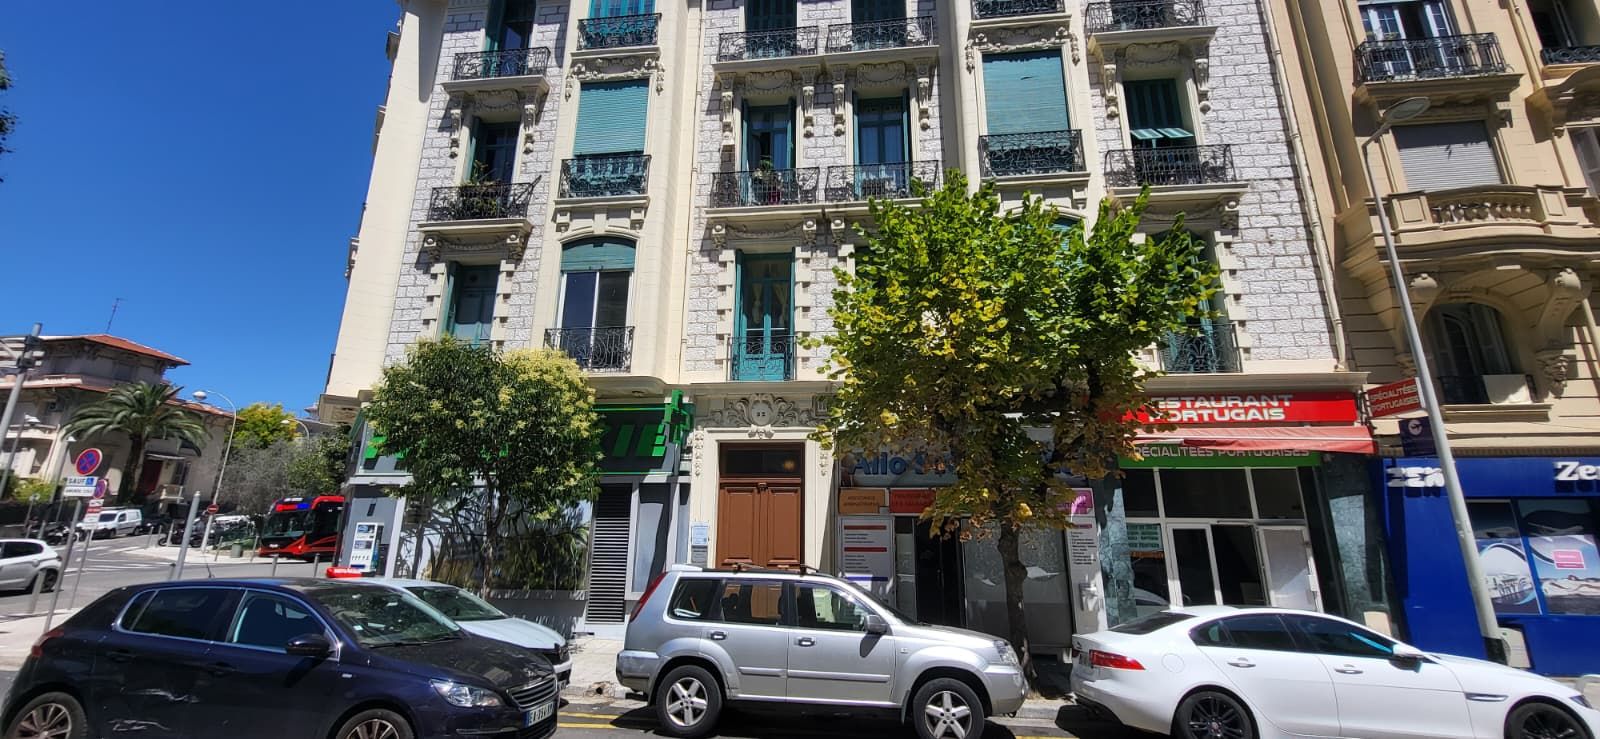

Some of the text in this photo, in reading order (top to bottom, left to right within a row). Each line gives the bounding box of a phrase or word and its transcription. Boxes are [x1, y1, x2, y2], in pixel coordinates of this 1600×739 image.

[1150, 394, 1294, 409] ESTAURANT
[1148, 407, 1287, 422] ORTUGAIS
[848, 451, 907, 476] Allo
[1552, 461, 1600, 481] Ze
